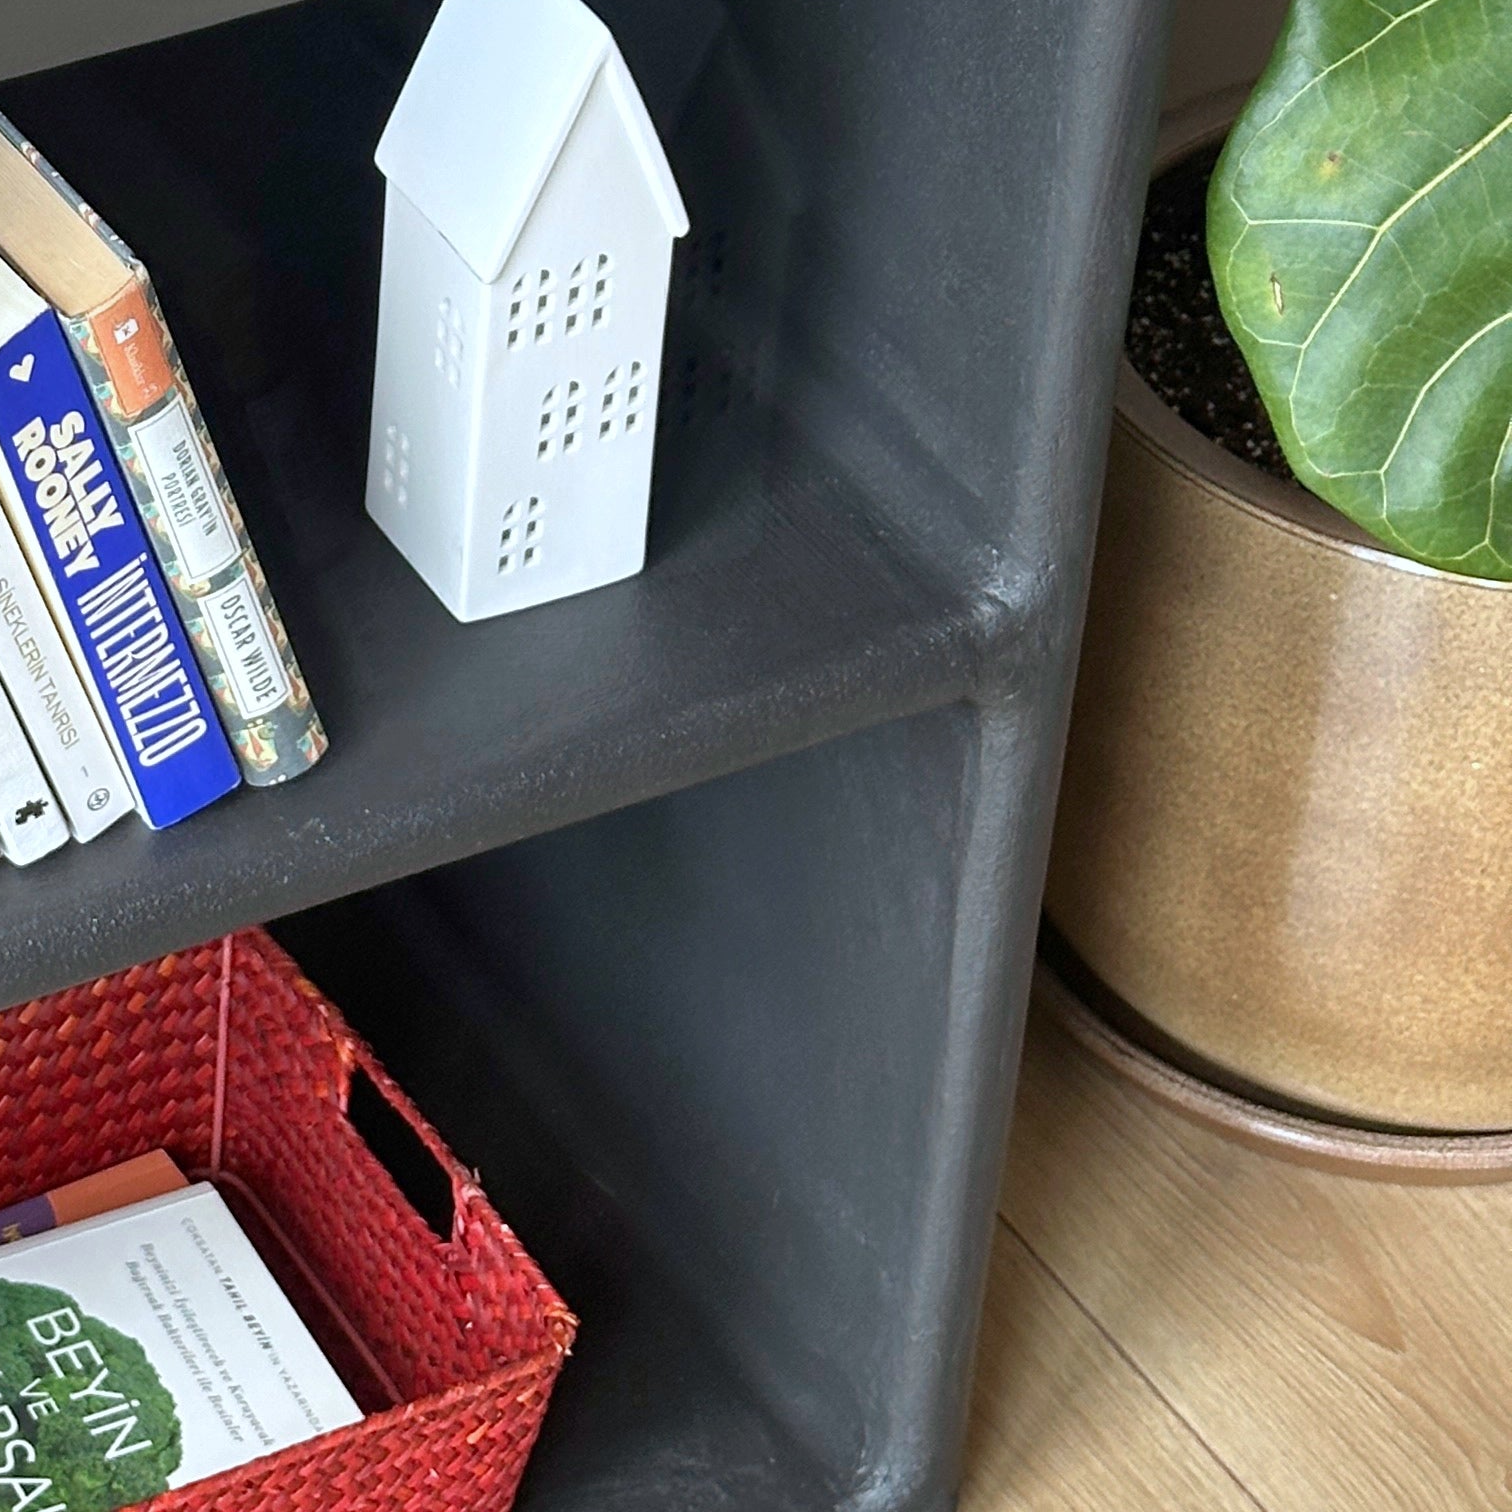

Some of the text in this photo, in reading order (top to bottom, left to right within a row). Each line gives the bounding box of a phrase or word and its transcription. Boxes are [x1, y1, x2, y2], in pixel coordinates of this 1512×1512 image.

[11, 416, 100, 579] ROONEY
[50, 410, 125, 537] SALLY
[172, 439, 201, 487] DORIAN
[220, 594, 278, 703] OSCAR WILDE
[38, 676, 81, 751] TANRISI
[19, 1377, 61, 1421] VE
[26, 1306, 154, 1461] BEYİN
